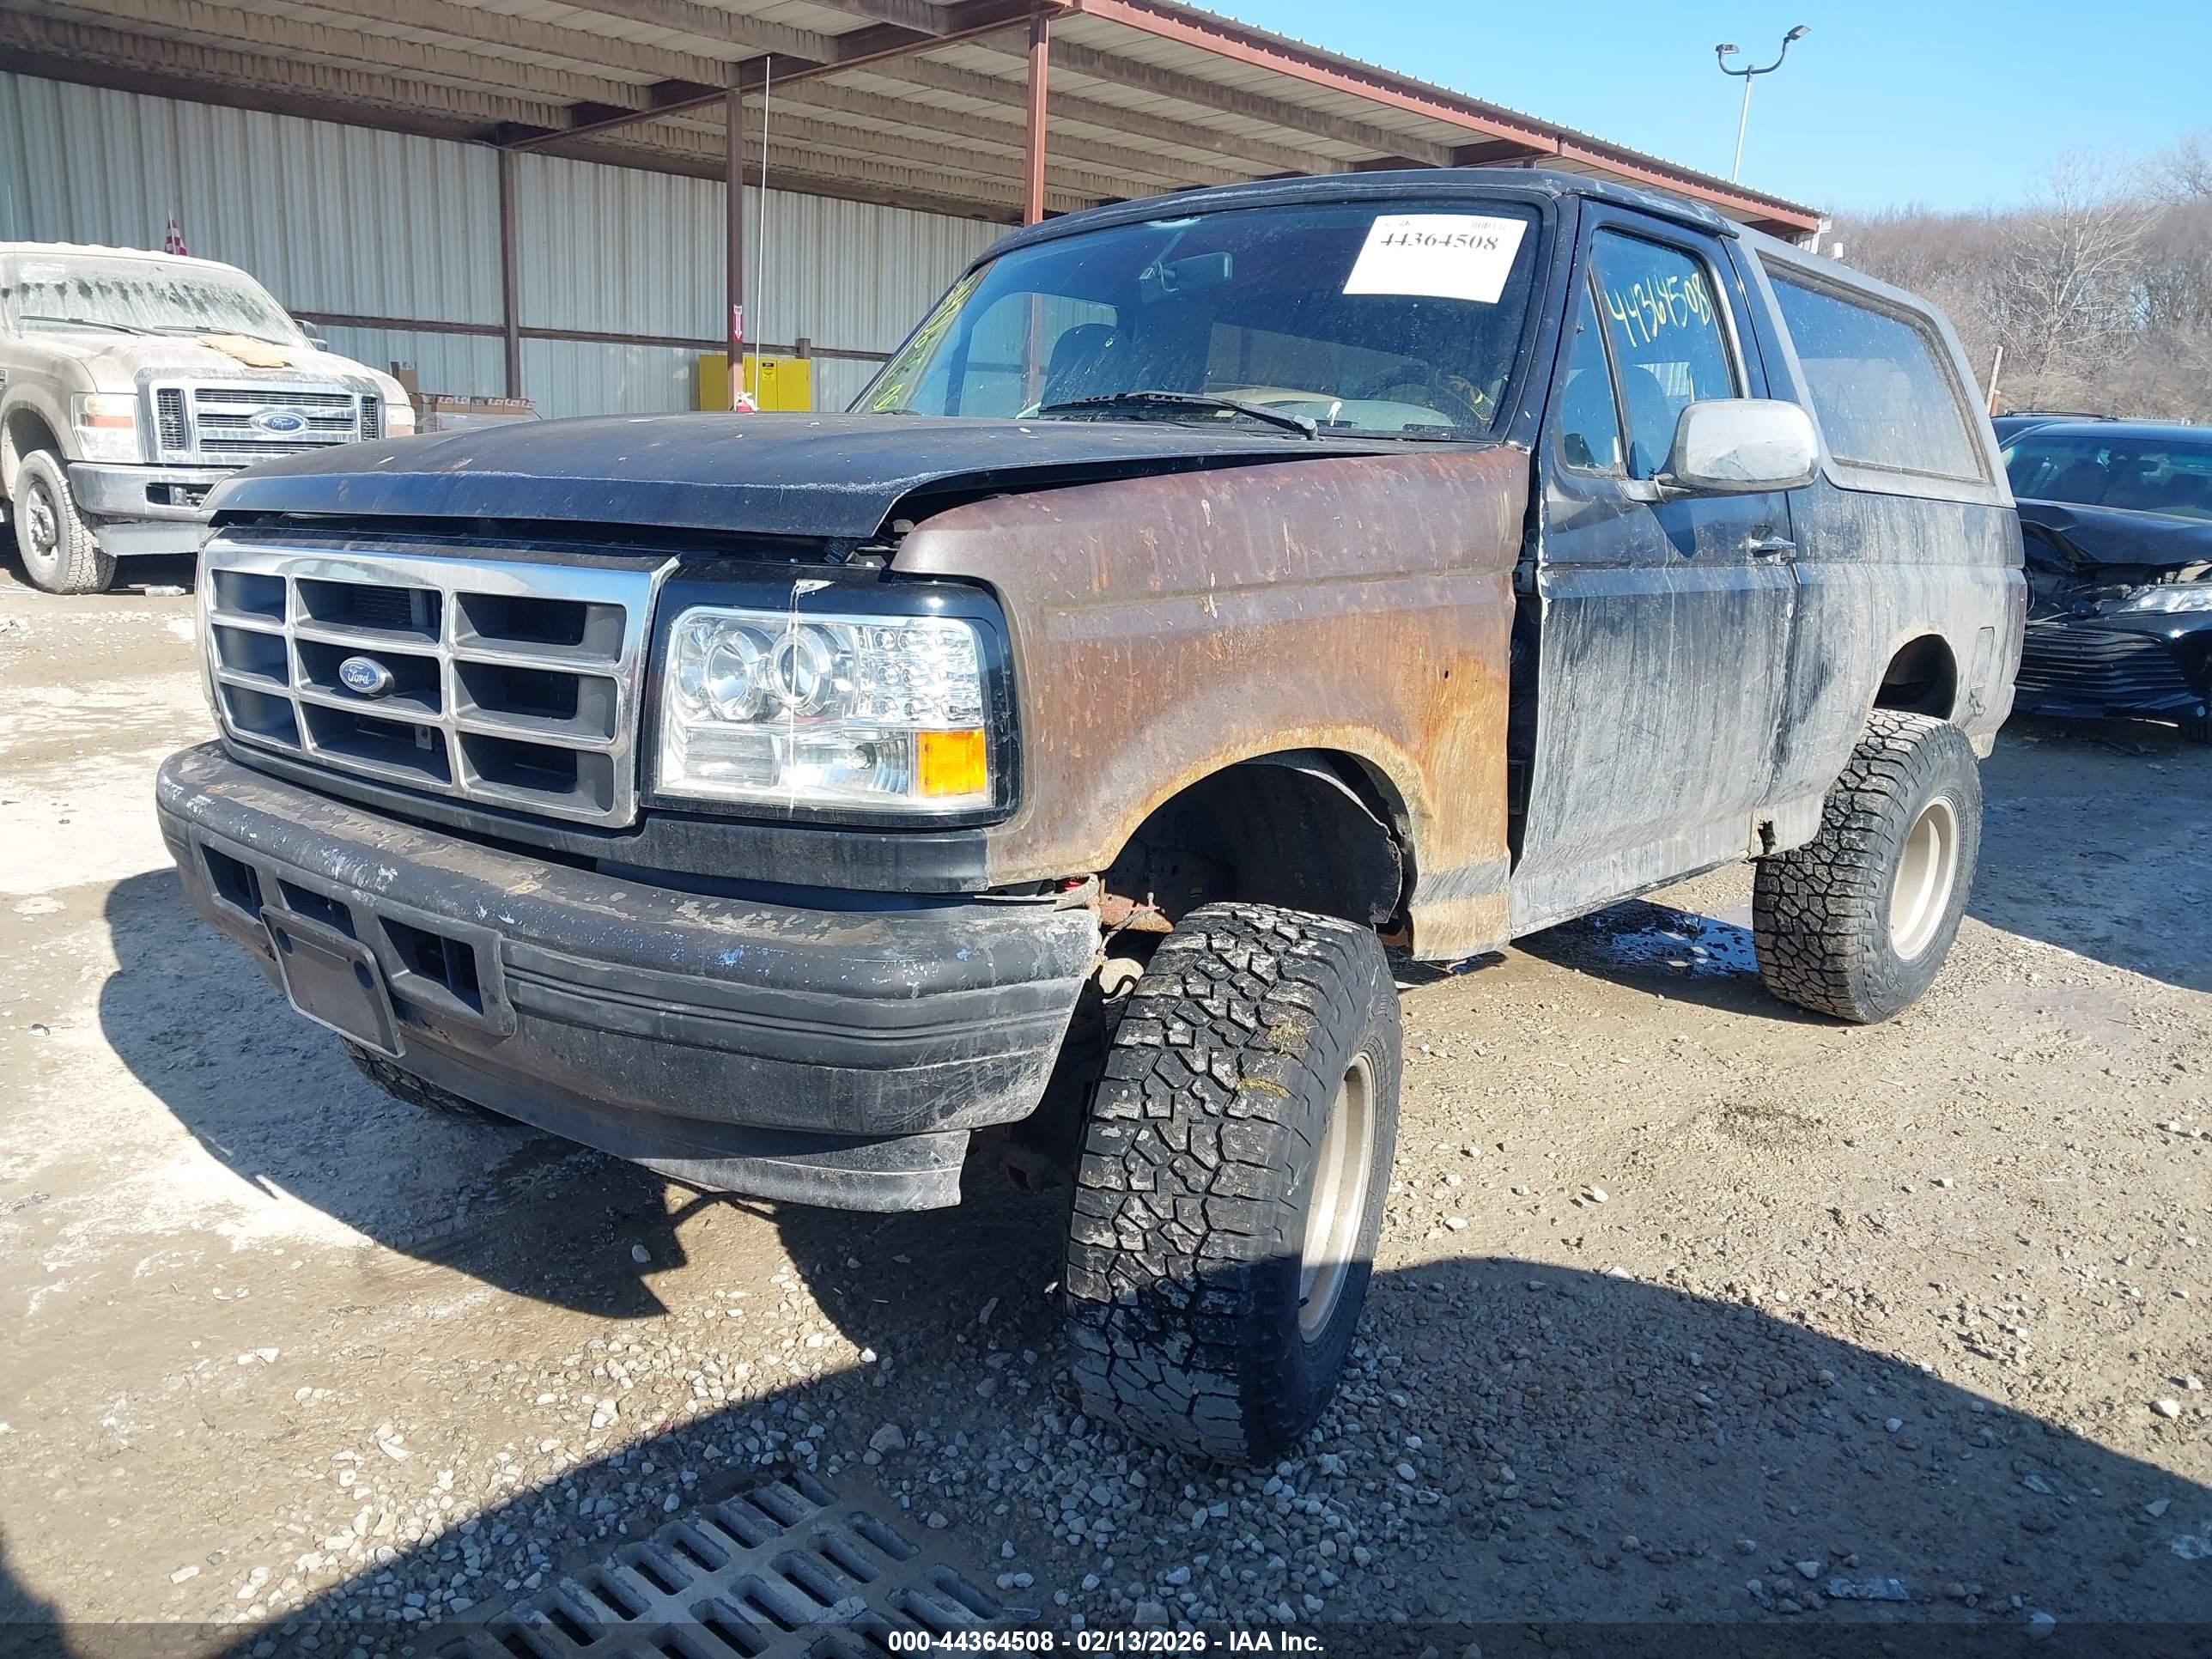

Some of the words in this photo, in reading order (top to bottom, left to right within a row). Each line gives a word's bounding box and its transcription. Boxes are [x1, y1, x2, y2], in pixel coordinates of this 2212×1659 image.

[1380, 232, 1499, 251] 44364508
[1604, 272, 1711, 348] 44364508
[347, 664, 372, 685] Ford
